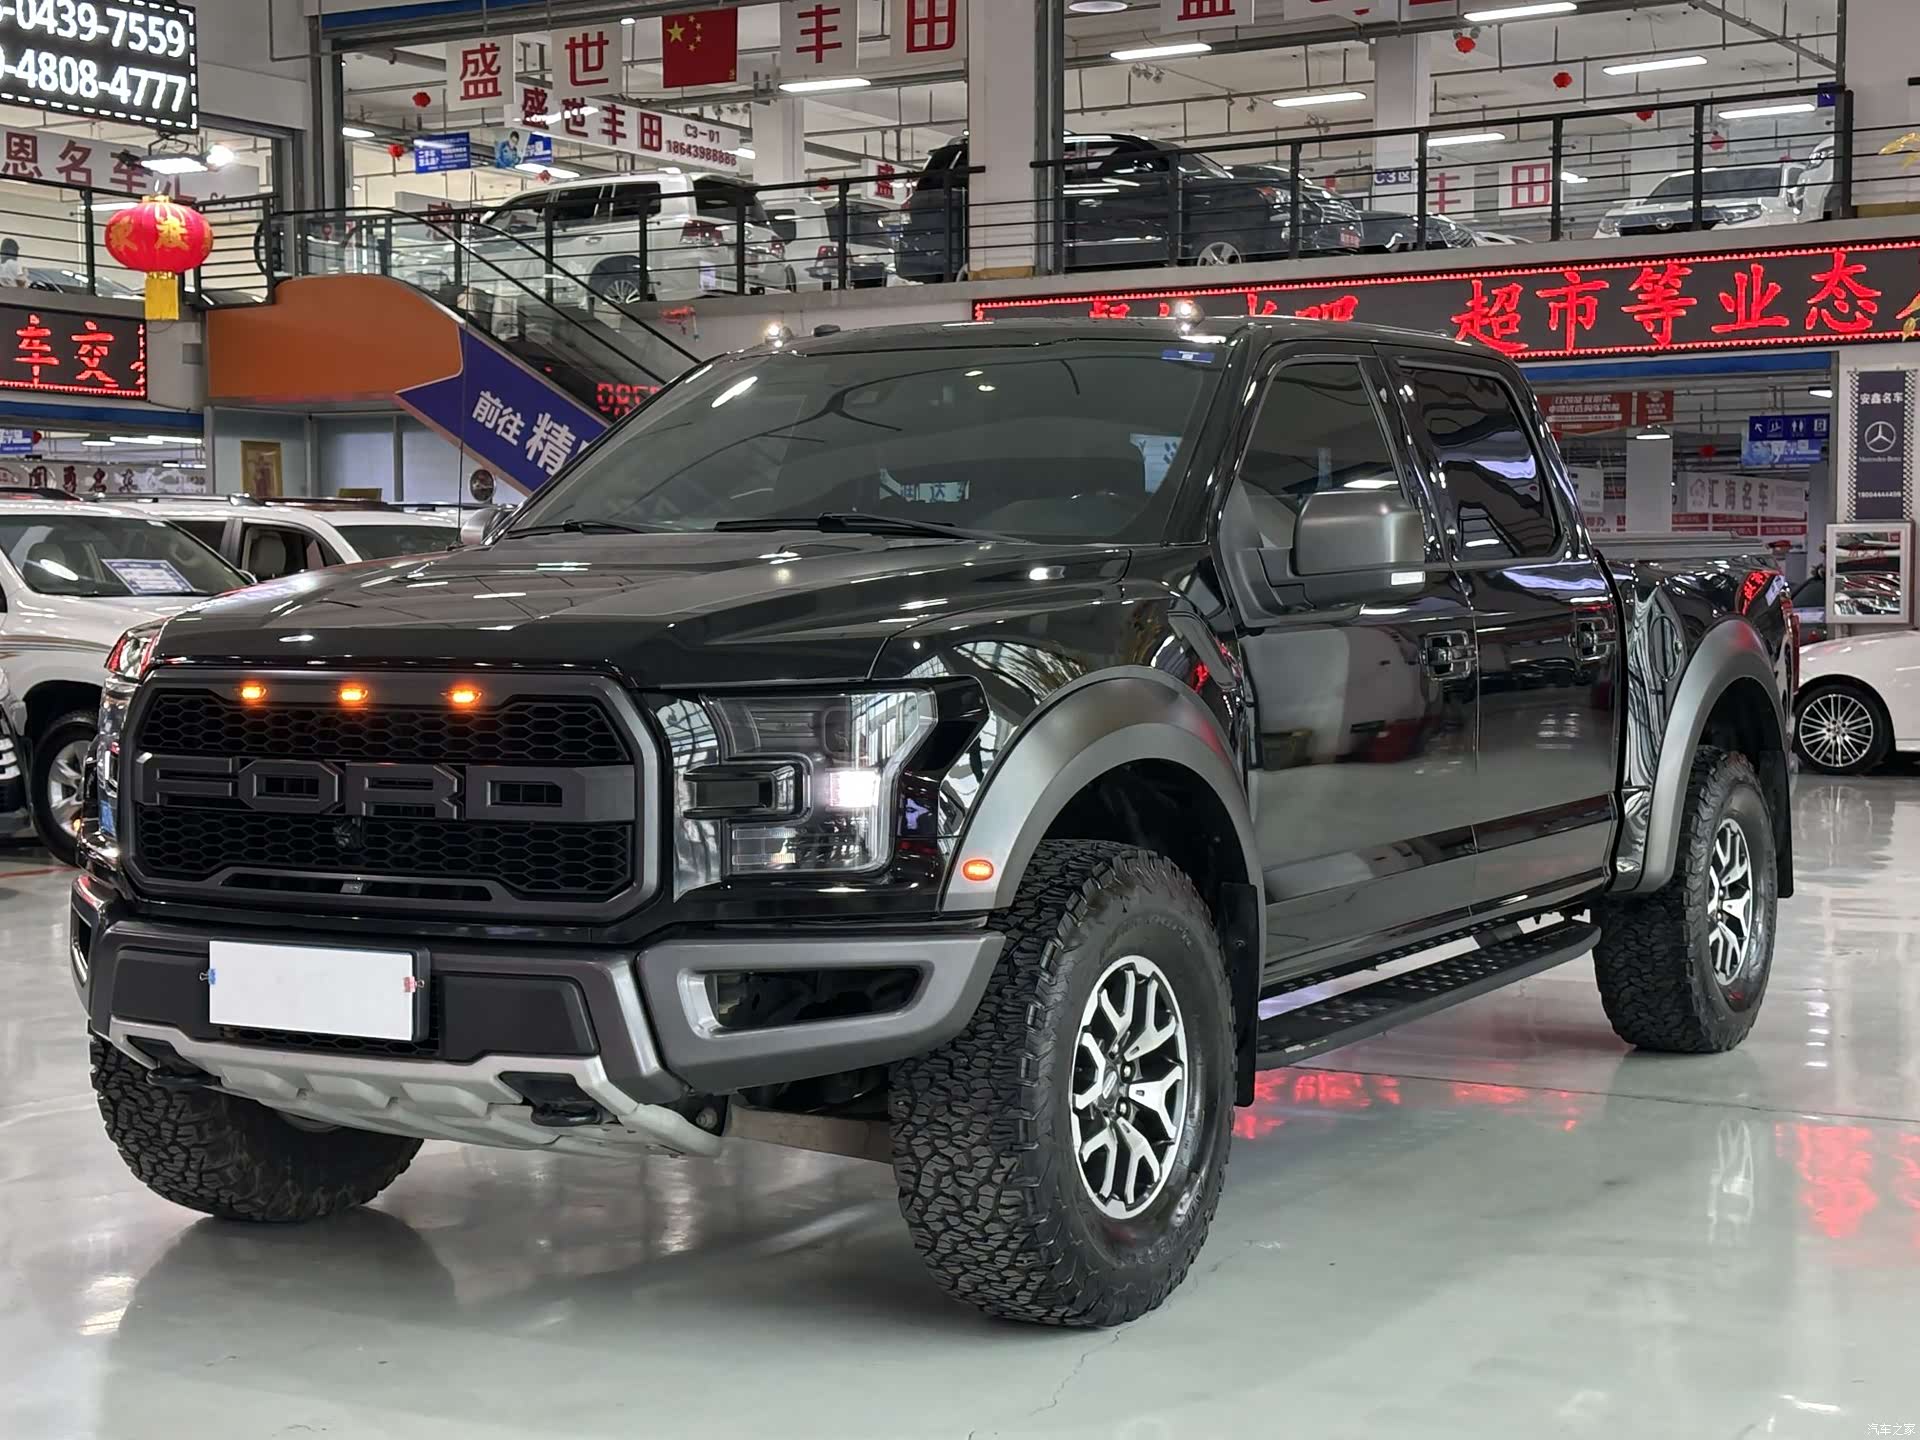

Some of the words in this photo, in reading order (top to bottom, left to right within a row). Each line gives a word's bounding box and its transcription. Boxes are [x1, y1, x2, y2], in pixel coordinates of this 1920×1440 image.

[0, 0, 186, 58] -0439-7559
[0, 42, 187, 113] -4808-4777
[1451, 251, 1883, 356] 超市等业态
[136, 752, 635, 823] FORD
